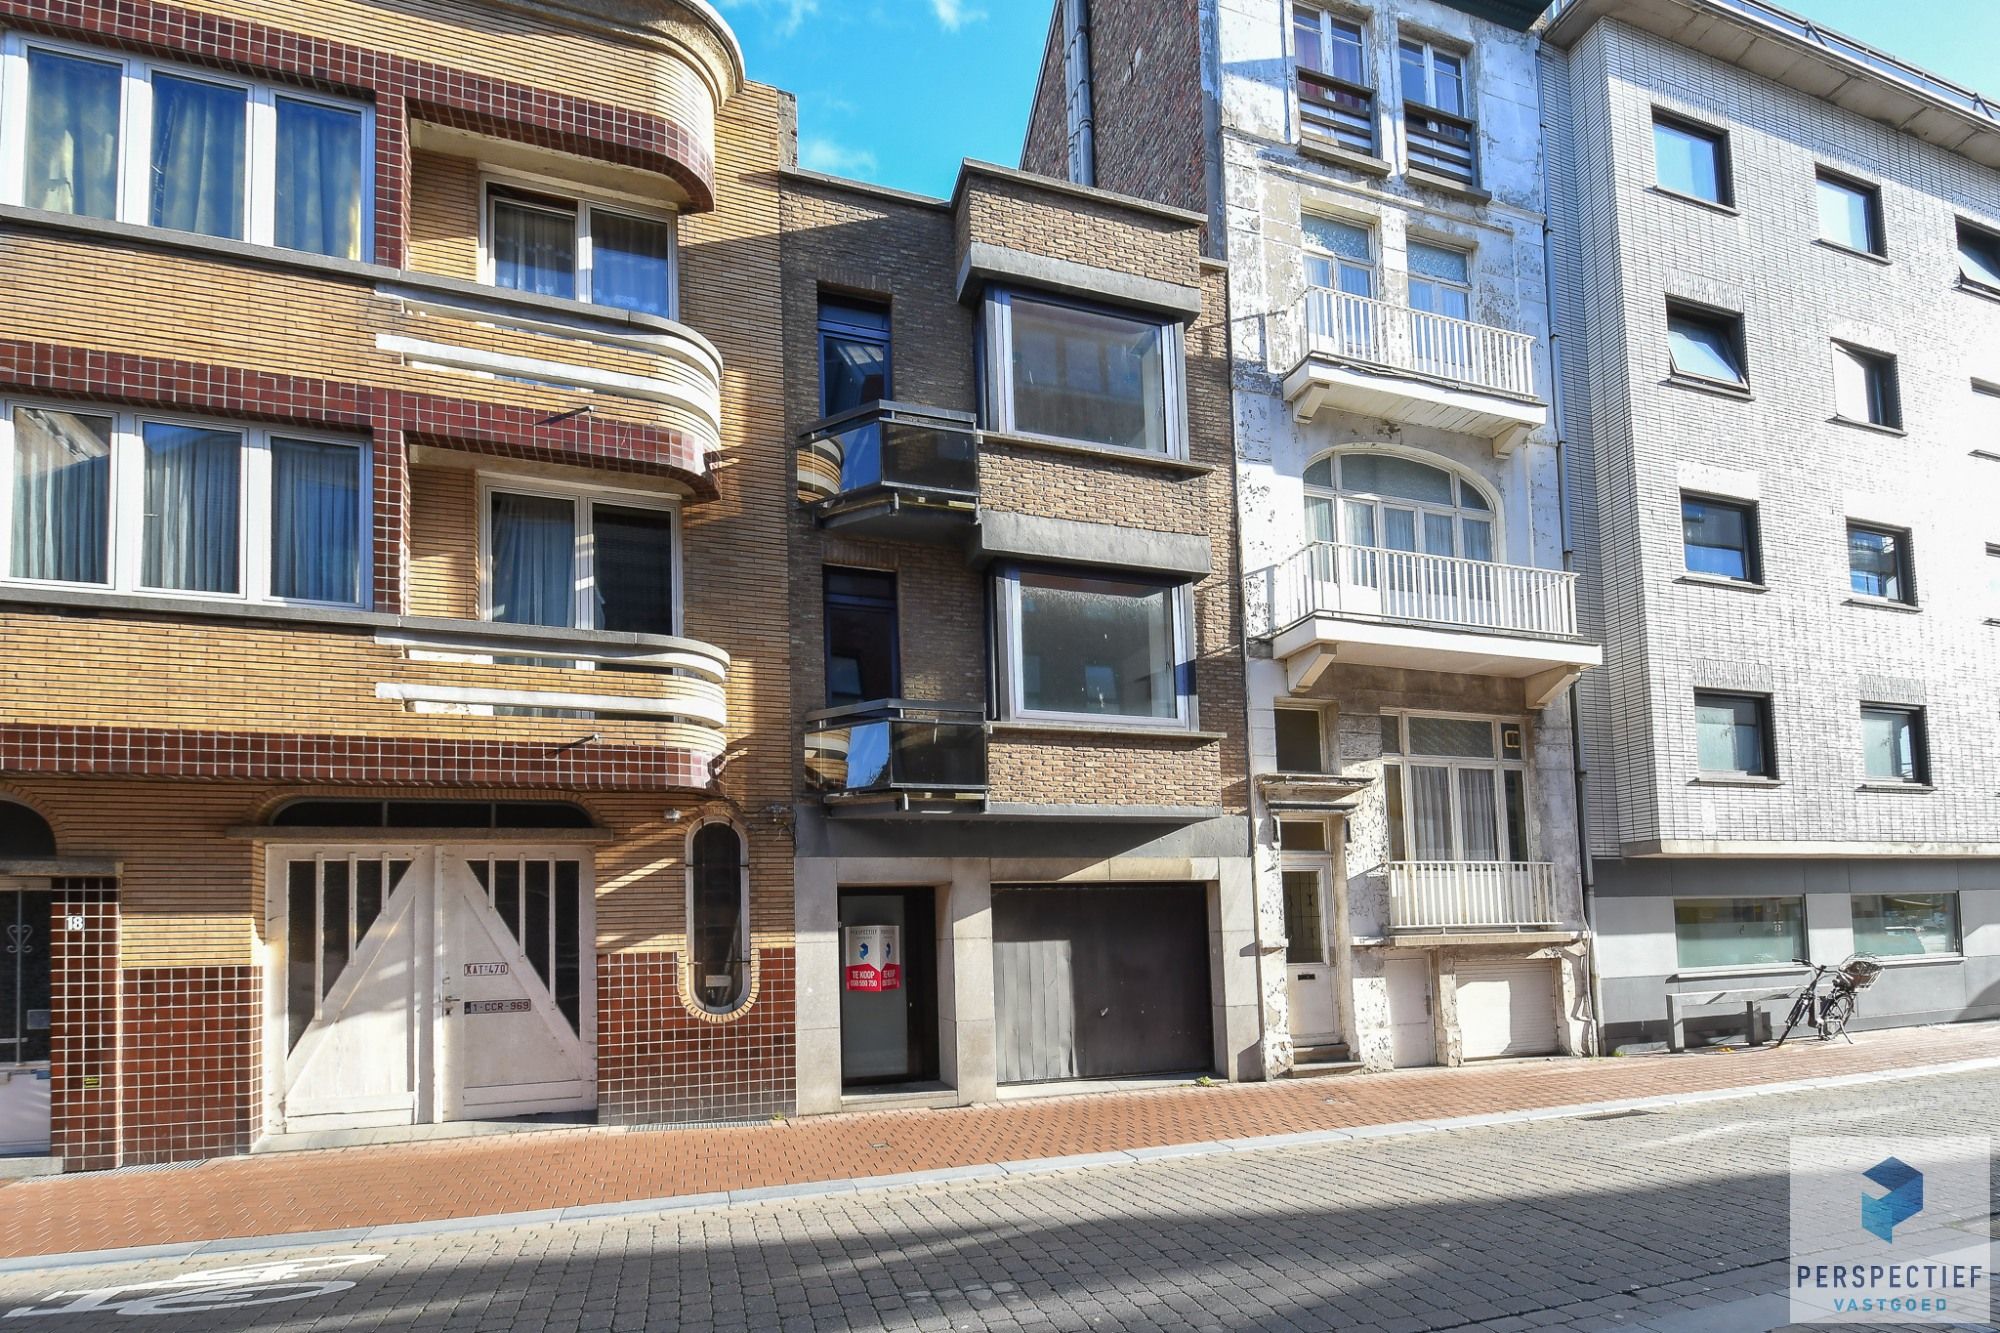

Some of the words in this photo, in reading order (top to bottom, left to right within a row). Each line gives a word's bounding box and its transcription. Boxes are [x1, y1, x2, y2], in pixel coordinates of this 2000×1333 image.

[66, 916, 83, 931] 18
[852, 970, 859, 979] TE
[860, 970, 875, 979] KOOP
[473, 1001, 529, 1011] 1-CCR-969
